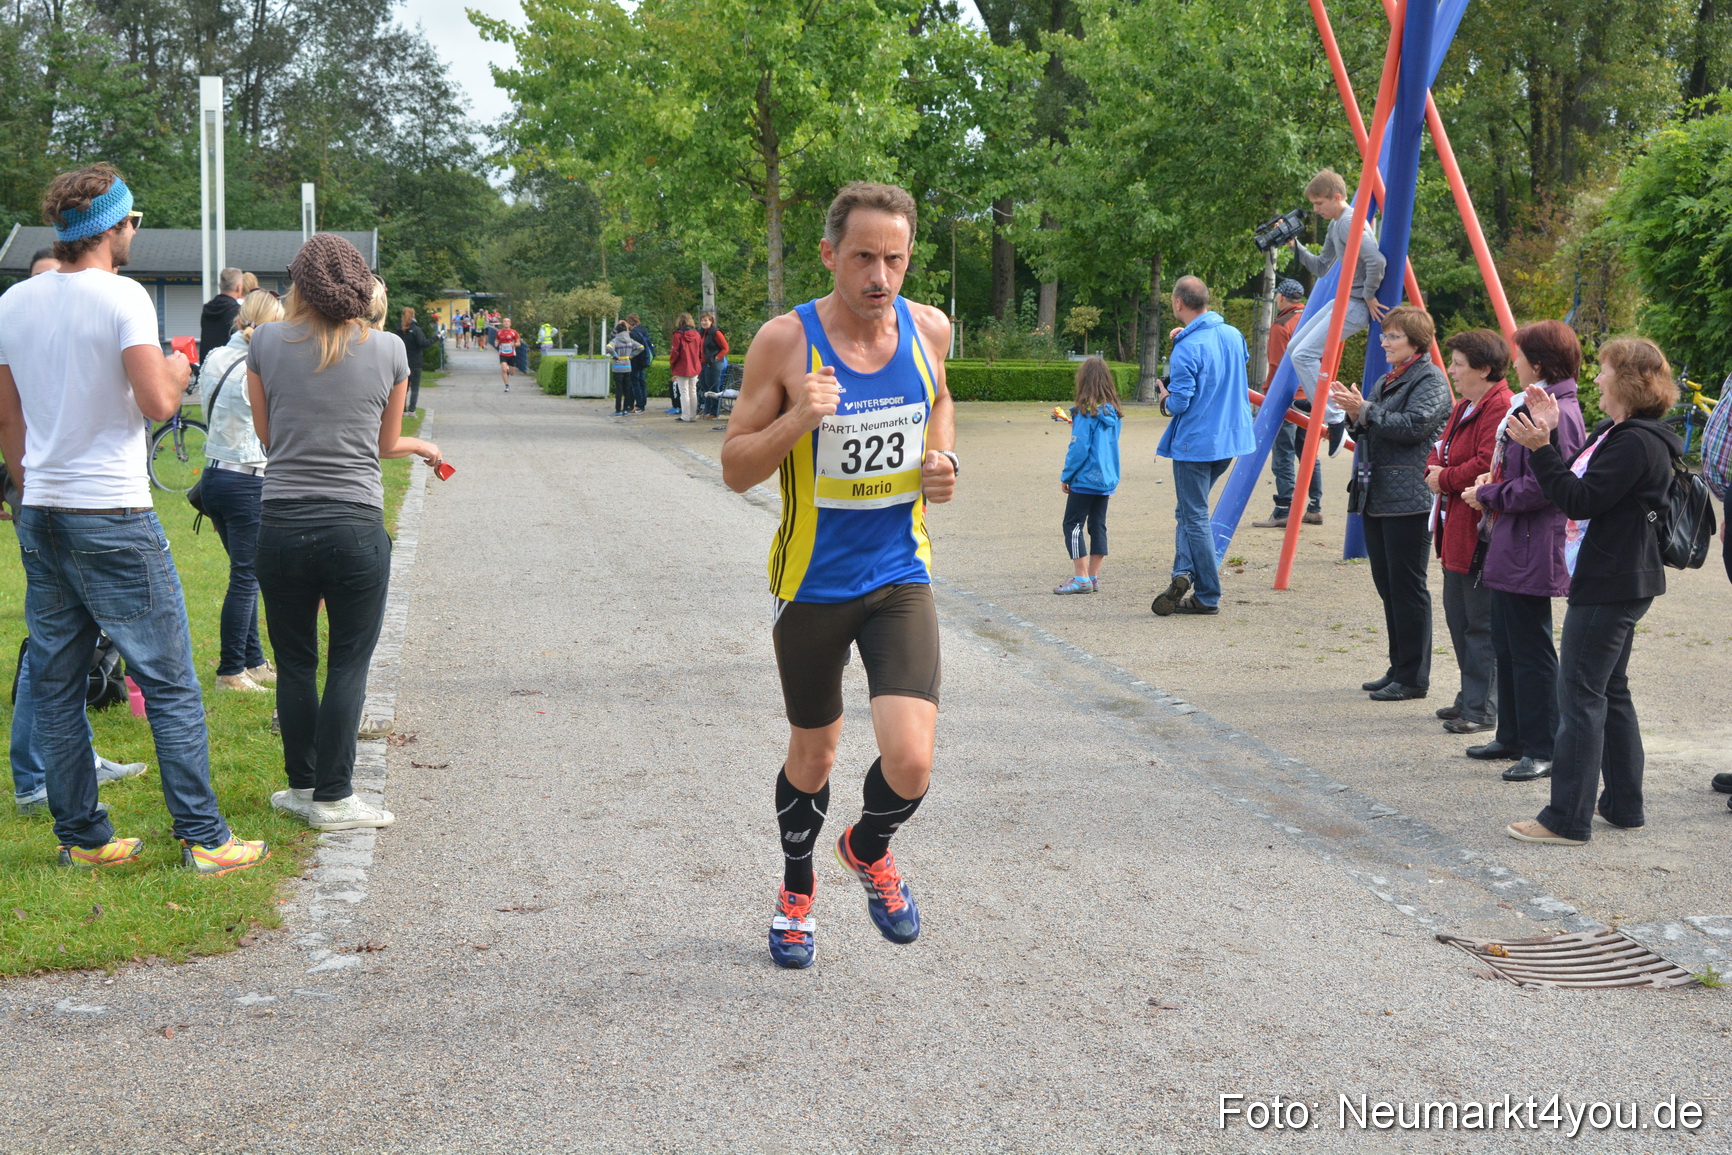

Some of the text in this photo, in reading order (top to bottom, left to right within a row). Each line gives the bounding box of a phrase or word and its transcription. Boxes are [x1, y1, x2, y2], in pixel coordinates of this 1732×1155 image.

[853, 396, 905, 410] INTERSPORT
[821, 416, 909, 435] PARTL Neumarkt
[841, 431, 905, 475] 323
[852, 480, 892, 497] Mario
